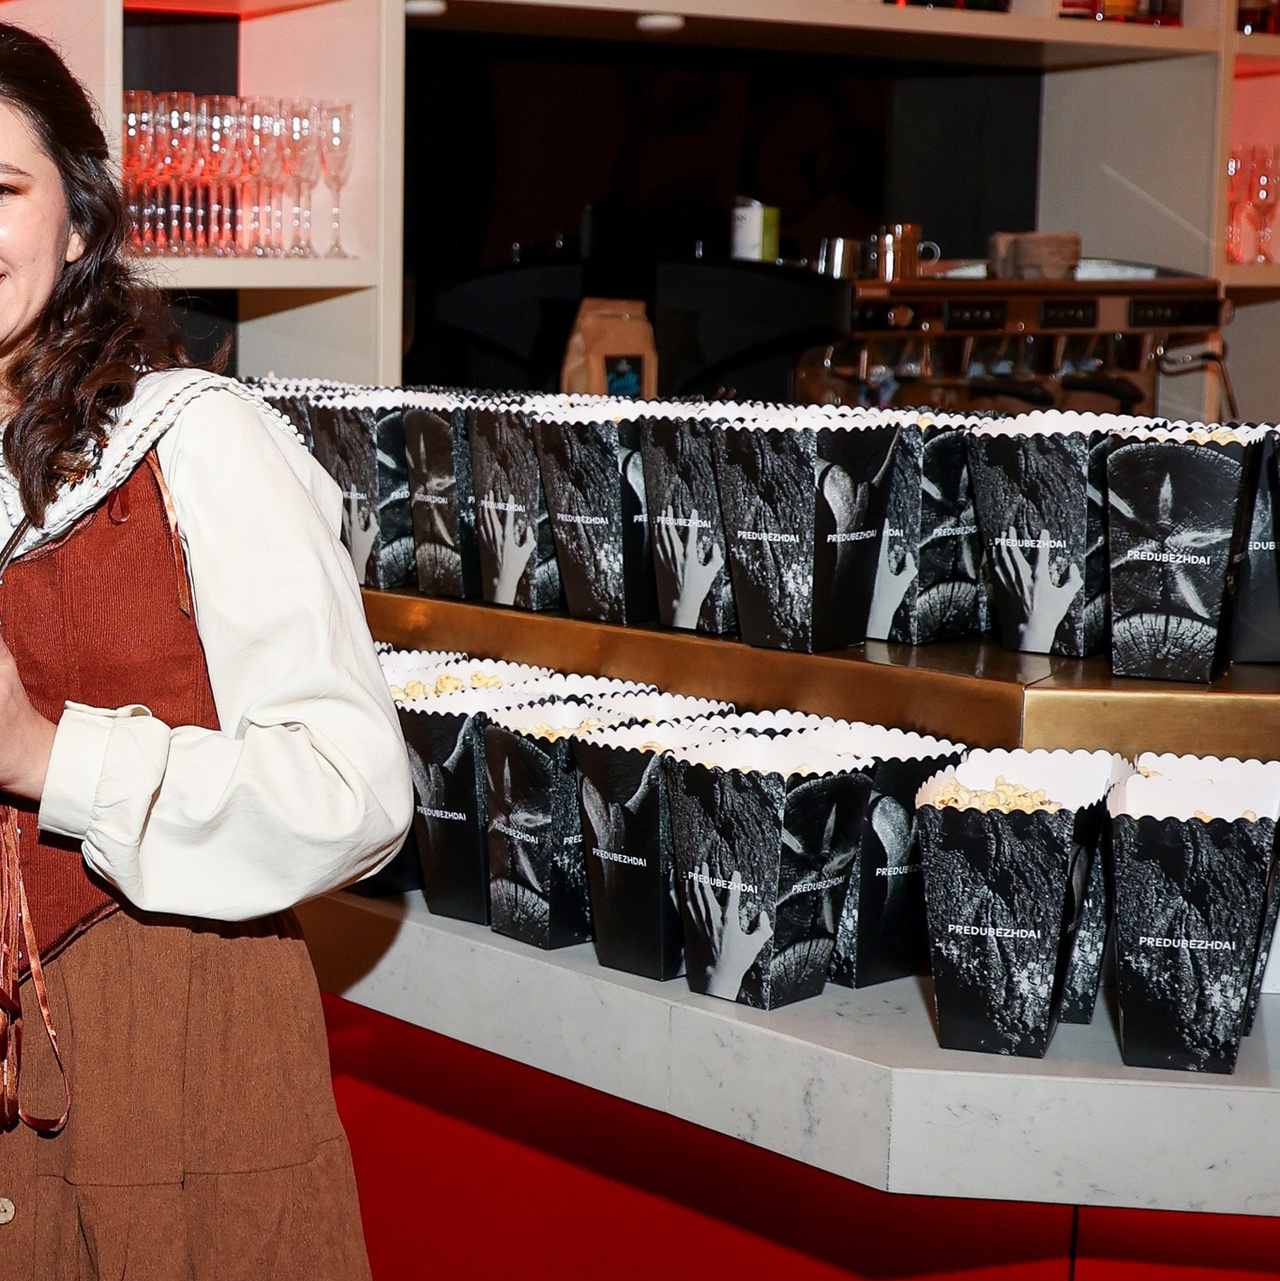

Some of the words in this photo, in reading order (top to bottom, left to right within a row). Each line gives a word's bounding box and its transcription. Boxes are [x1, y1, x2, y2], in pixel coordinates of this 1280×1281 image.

[556, 512, 609, 525] PREDUBEZHDAI
[656, 515, 712, 529] PREDUBEZHDAI
[737, 530, 800, 543] PREDUBEZHDAI
[826, 529, 878, 543] PREDUBEZHDAI
[932, 525, 977, 537] PREDUBEZHD
[994, 536, 1067, 549] PREDUBEZHDAI
[1126, 549, 1211, 566] PREDUBEZHDAI
[416, 805, 467, 822] PREDUBEZHDAI
[493, 819, 539, 845] PREDUBEZHDAI
[592, 847, 647, 868] PREDUBEZHDAI
[688, 871, 759, 895] PREDUBEZHDAI
[791, 874, 846, 894] PREDUBEZHDAI
[948, 923, 1042, 939] PREDUBEZHDAI
[1138, 935, 1236, 951] PREDUBEZHDAI
